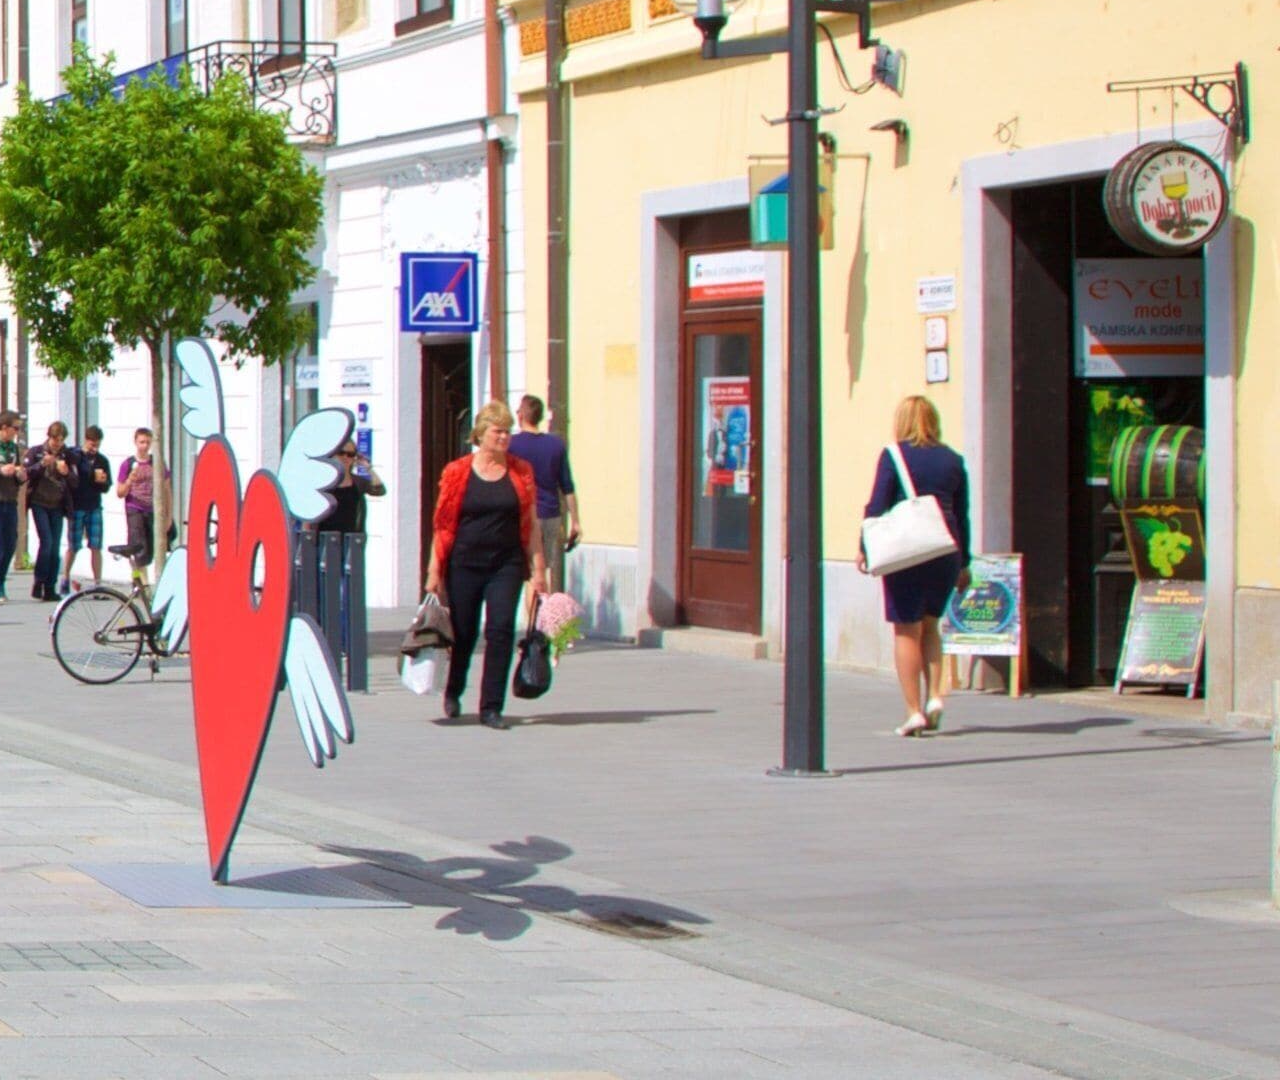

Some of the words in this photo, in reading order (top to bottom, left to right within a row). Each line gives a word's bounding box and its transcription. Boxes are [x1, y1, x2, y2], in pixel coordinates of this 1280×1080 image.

[1184, 189, 1217, 218] pocit
[412, 291, 462, 318] AXA
[1134, 303, 1182, 319] mode
